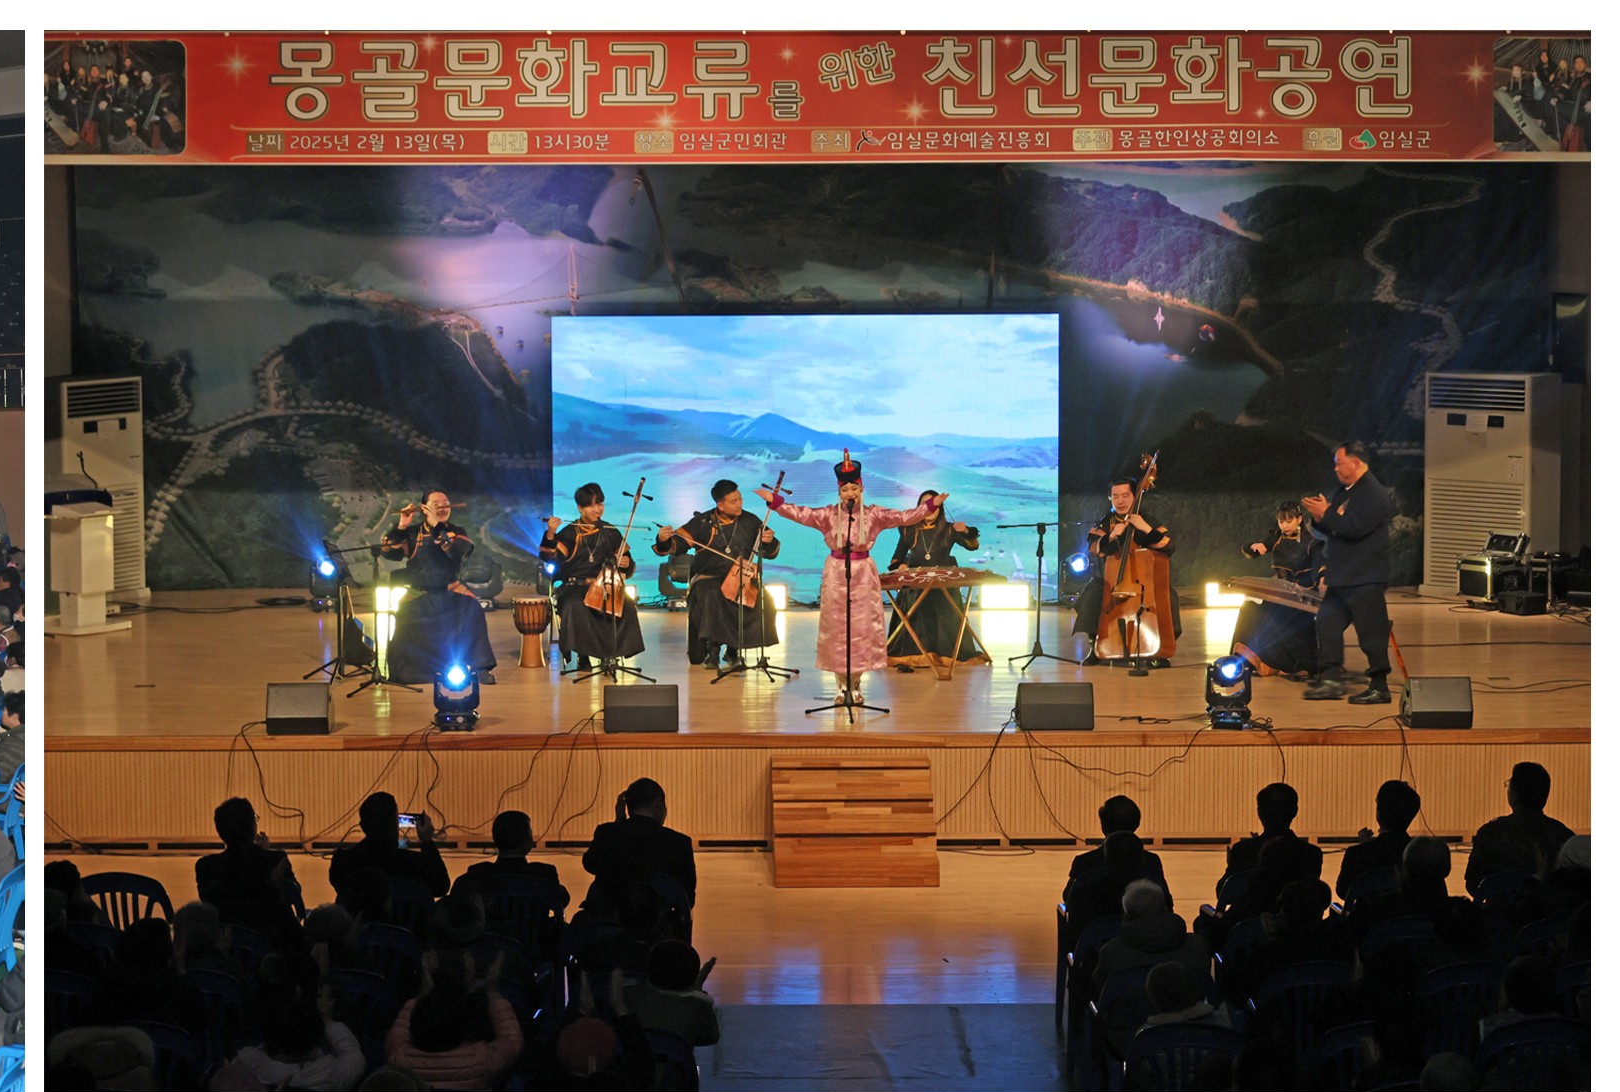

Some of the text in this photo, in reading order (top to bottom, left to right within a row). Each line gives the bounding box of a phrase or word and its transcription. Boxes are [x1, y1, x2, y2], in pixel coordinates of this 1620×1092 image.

[268, 36, 1413, 121] 몽골문화교류를 위한 친선문화공연
[248, 129, 1431, 152] 날짜 2025년 2월 13일(목) 시간 13시30분 장소 임실군민회관 주최 임실문화예술진흥회 주관 몽골한인상공회의소 후원 임실군
